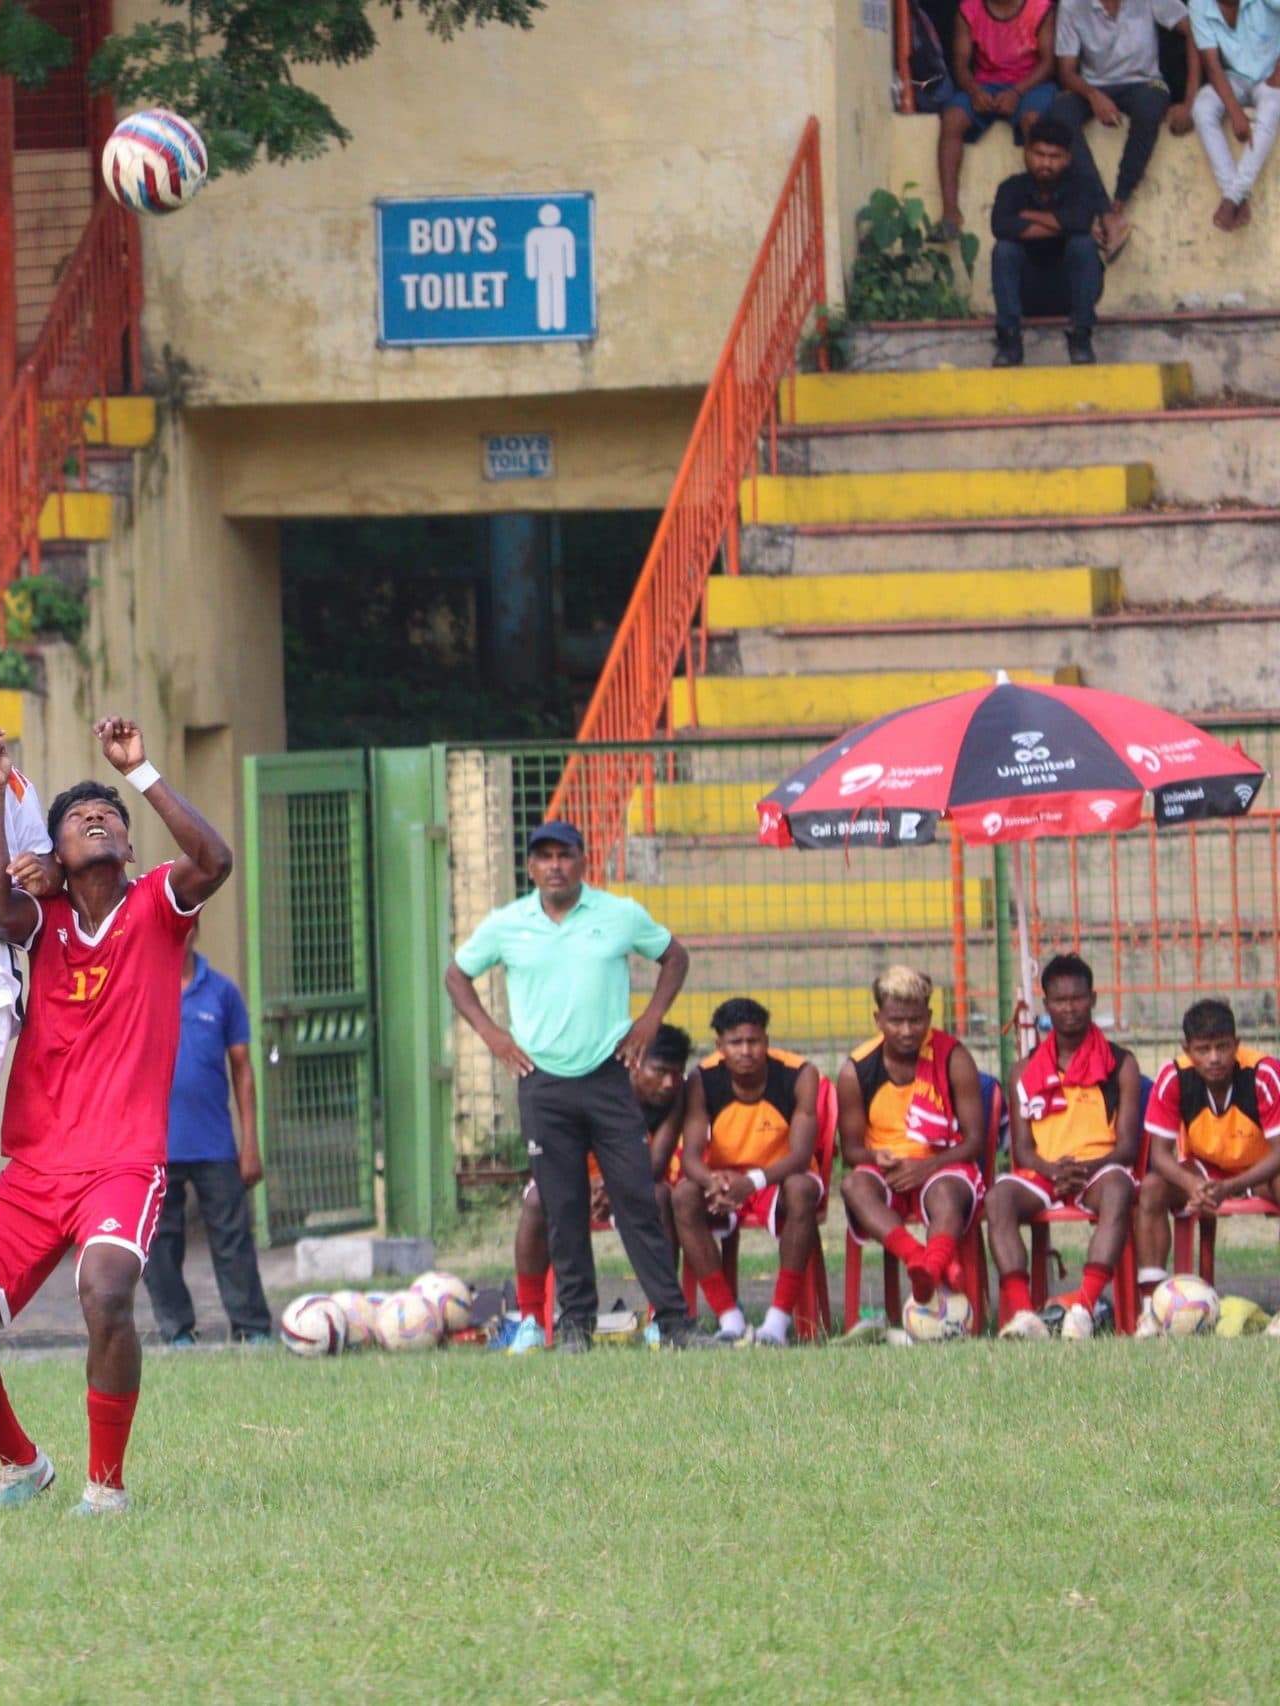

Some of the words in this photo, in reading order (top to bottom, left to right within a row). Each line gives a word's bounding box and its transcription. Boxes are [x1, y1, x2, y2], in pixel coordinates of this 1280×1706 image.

[409, 216, 498, 254] BOYS
[401, 272, 508, 309] TOILET
[488, 436, 549, 451] BOYS
[488, 453, 549, 472] TOILET
[997, 758, 1075, 777] Unlimited
[1021, 773, 1058, 786] data
[1162, 786, 1205, 805] Unlimited
[1164, 804, 1185, 817] data
[810, 822, 831, 837] Call
[68, 966, 108, 1001] 17
